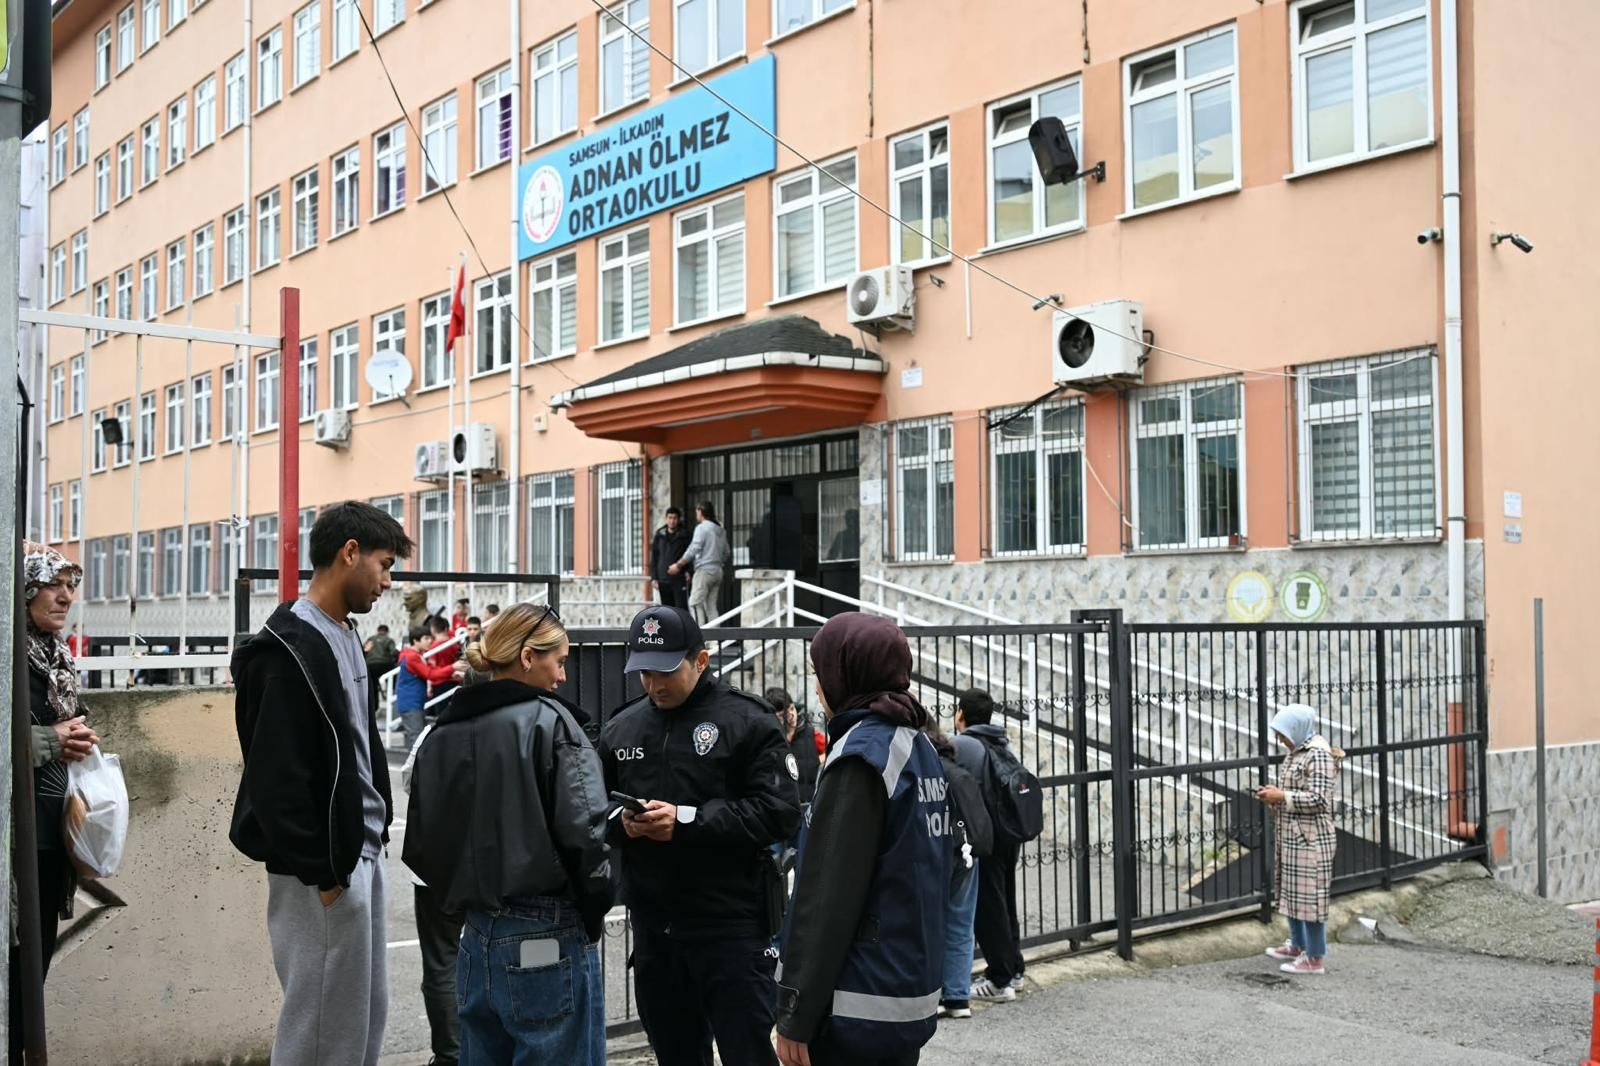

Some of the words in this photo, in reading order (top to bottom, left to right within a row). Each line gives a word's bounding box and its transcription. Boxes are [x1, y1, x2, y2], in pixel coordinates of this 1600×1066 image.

[569, 137, 610, 167] SAMSUN
[569, 147, 643, 203] ADNAN
[649, 111, 730, 170] ÖLMEZ
[568, 161, 701, 236] ORTAOKULU
